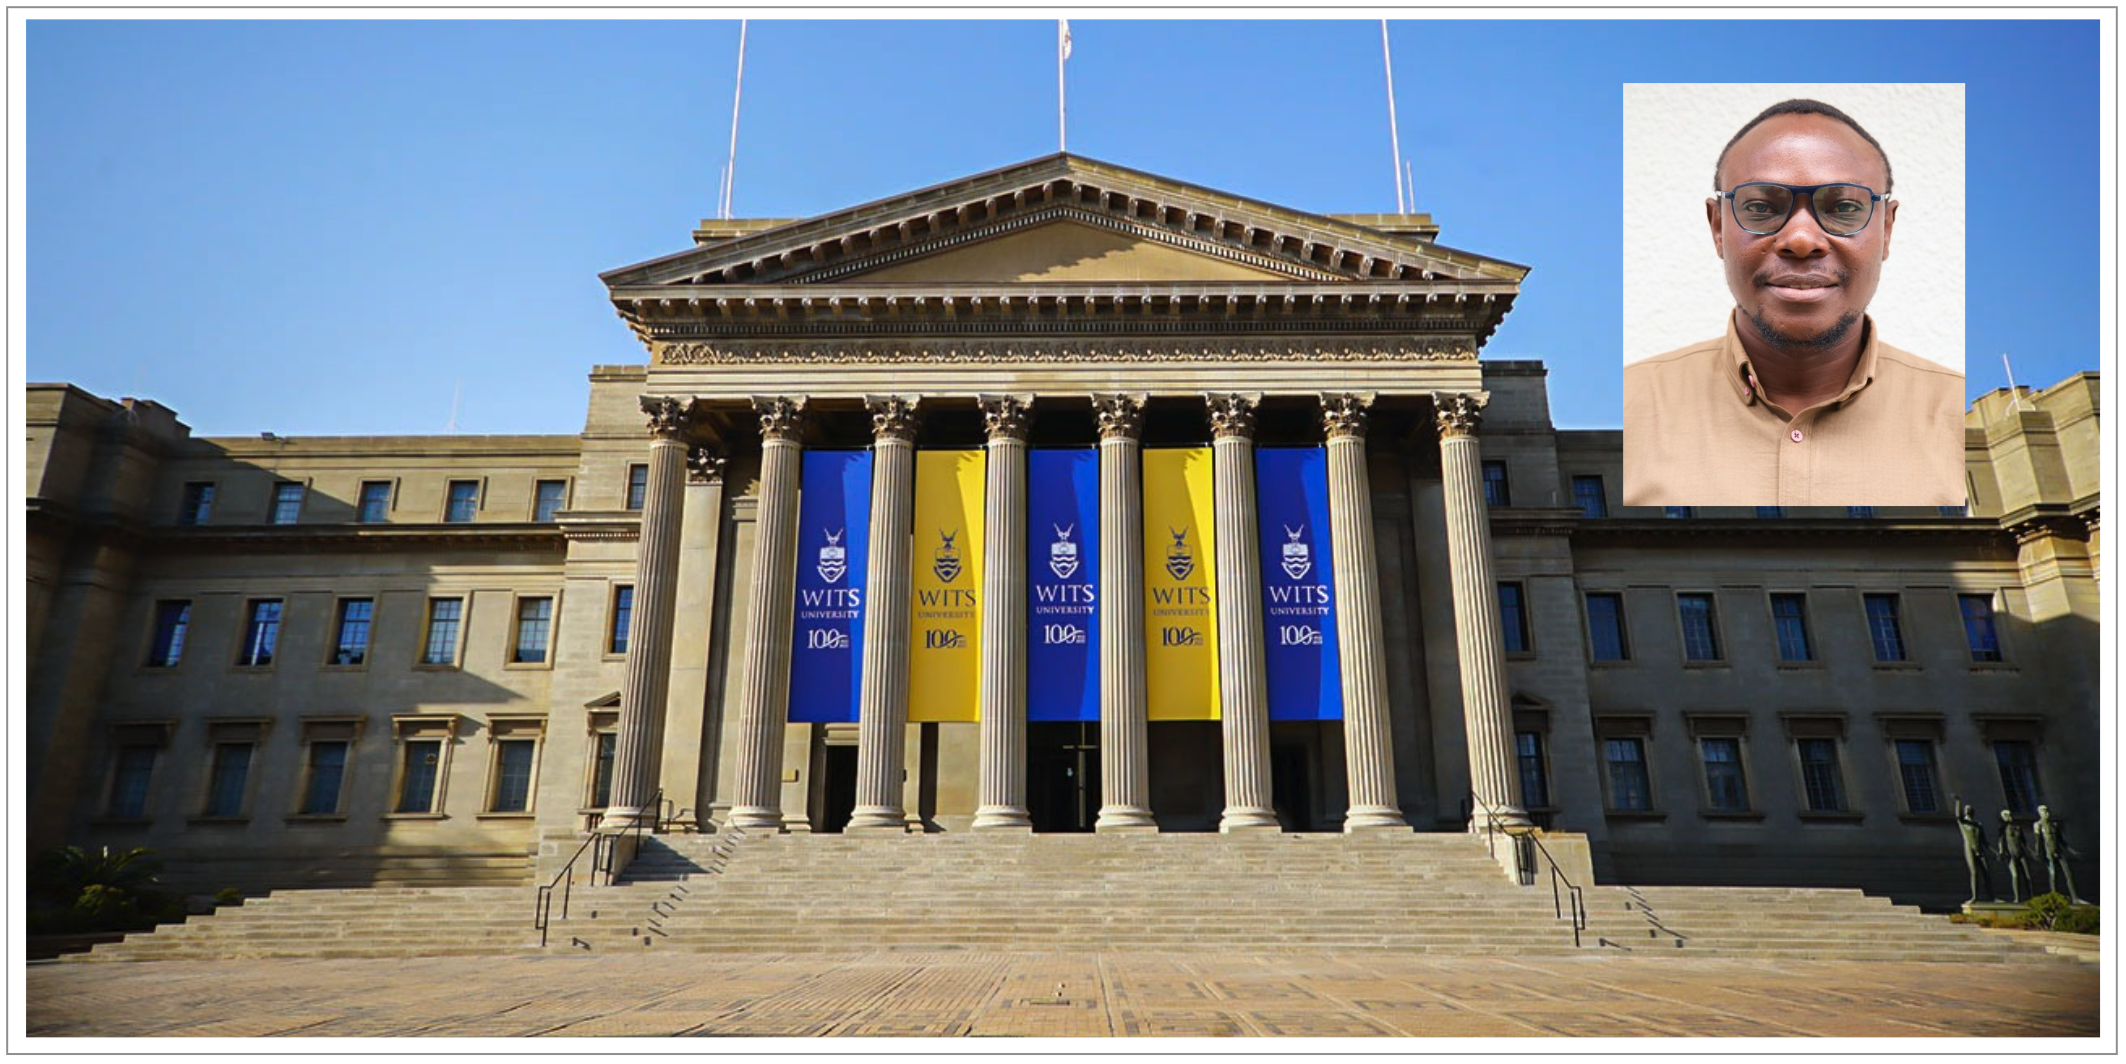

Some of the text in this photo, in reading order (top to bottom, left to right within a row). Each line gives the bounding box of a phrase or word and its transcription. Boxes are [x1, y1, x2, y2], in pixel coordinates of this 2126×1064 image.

[802, 589, 860, 607] WITS
[918, 589, 976, 607] WITS
[1036, 584, 1095, 602] WITS
[1153, 587, 1211, 604] WITS
[1270, 585, 1329, 603] WITS
[801, 610, 859, 619] UNIVERSITY
[1036, 605, 1095, 614] UNIVERSITY
[1270, 607, 1329, 615] UNIVERSITY
[808, 628, 842, 648] 100
[926, 629, 958, 649] 100
[1044, 624, 1077, 644] 100
[1162, 627, 1195, 646] 100
[1280, 625, 1313, 645] 100
